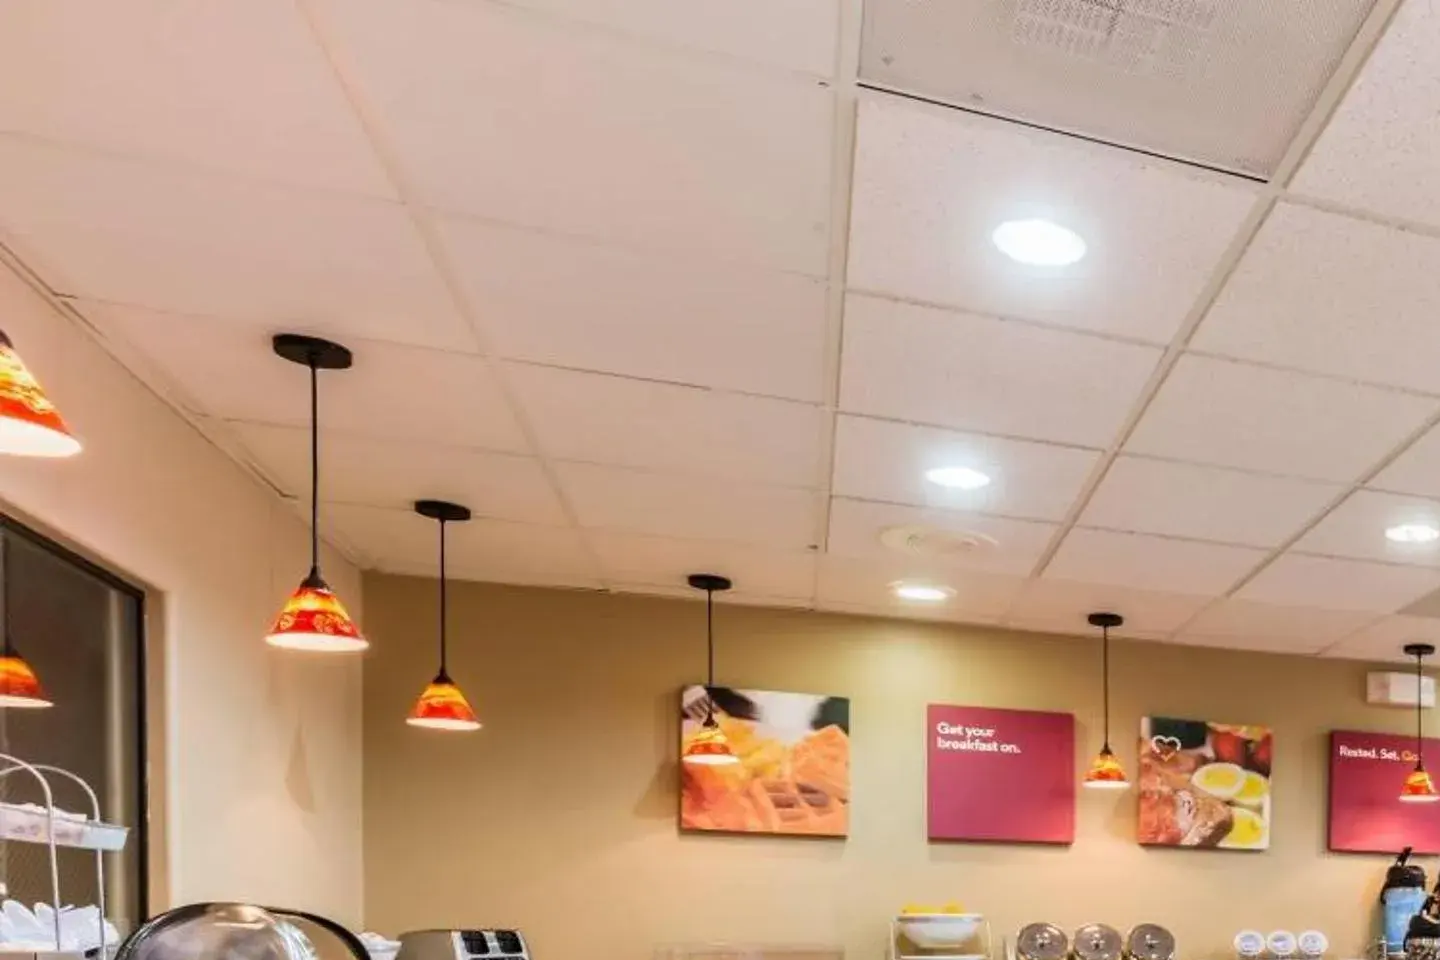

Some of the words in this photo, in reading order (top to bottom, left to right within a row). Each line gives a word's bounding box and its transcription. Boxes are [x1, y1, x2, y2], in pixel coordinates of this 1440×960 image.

[936, 721, 963, 735] Get
[965, 726, 995, 738] your
[936, 736, 998, 752] breakfast
[1000, 743, 1022, 754] on.
